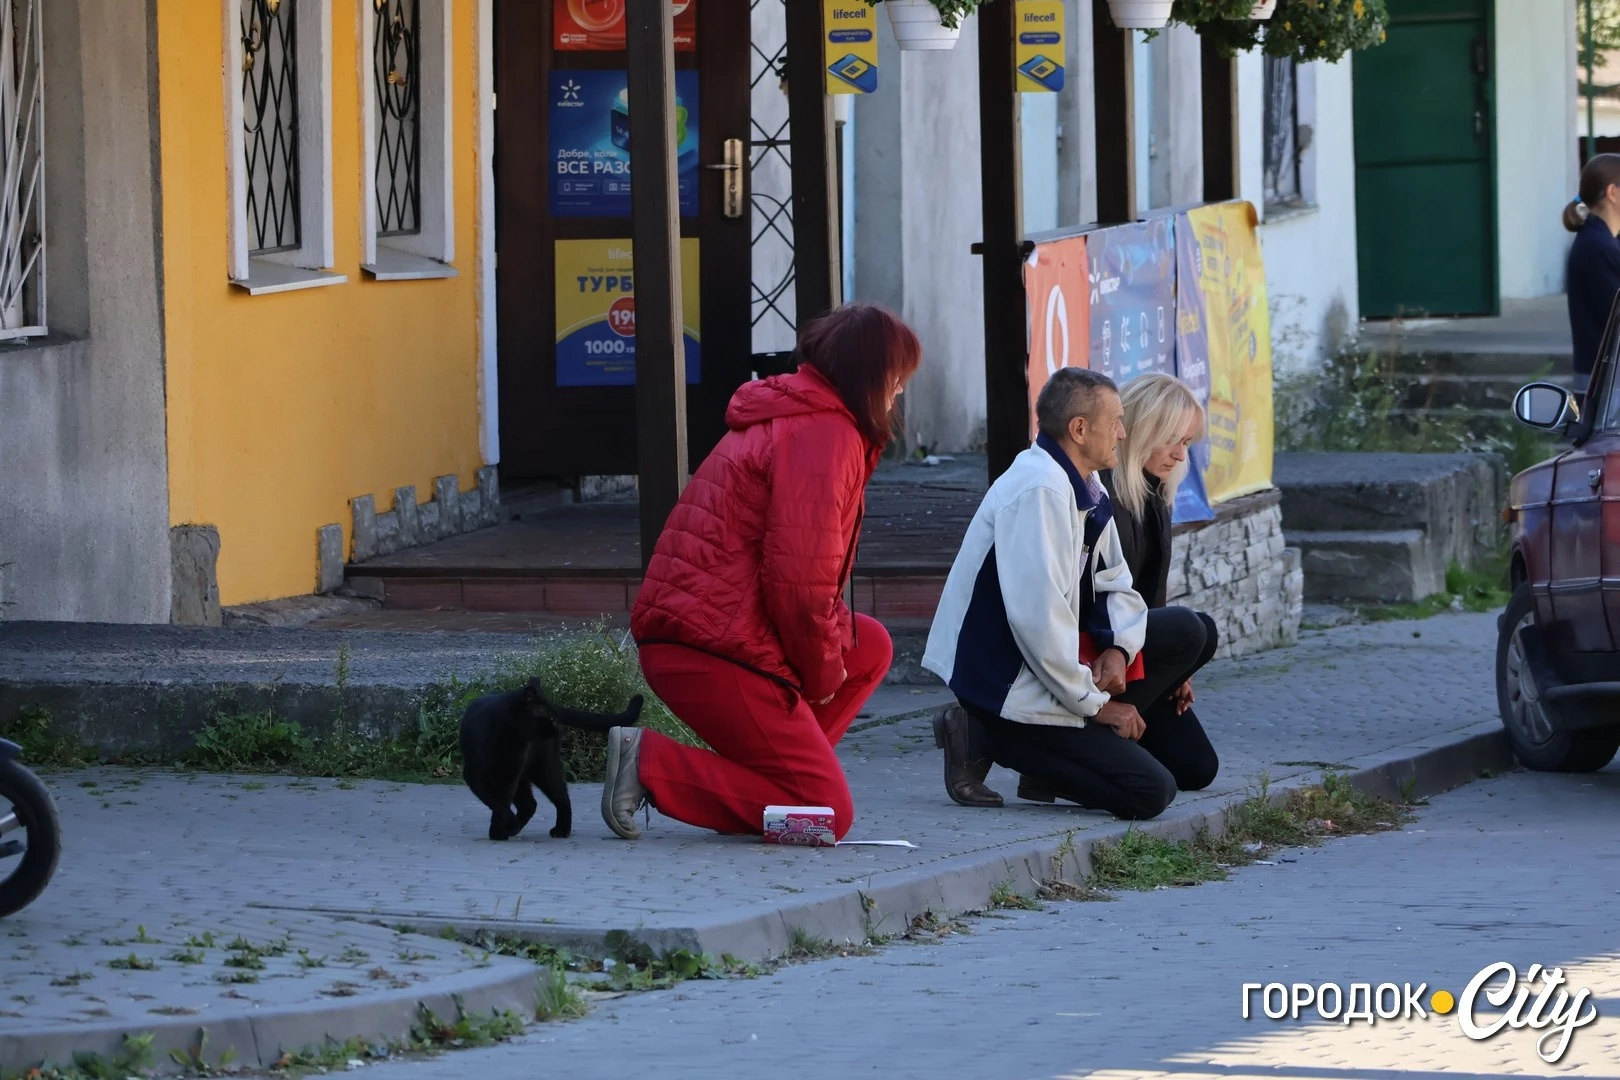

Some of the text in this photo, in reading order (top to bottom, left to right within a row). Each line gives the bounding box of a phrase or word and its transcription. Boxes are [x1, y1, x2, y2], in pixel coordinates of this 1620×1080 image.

[833, 8, 866, 19] lifecell
[1024, 13, 1055, 22] lifecell
[558, 150, 592, 160] Добре,
[557, 161, 589, 174] ВСЕ
[608, 248, 633, 259] lifec
[577, 276, 634, 292] ТУРБ
[584, 340, 625, 354] 1000
